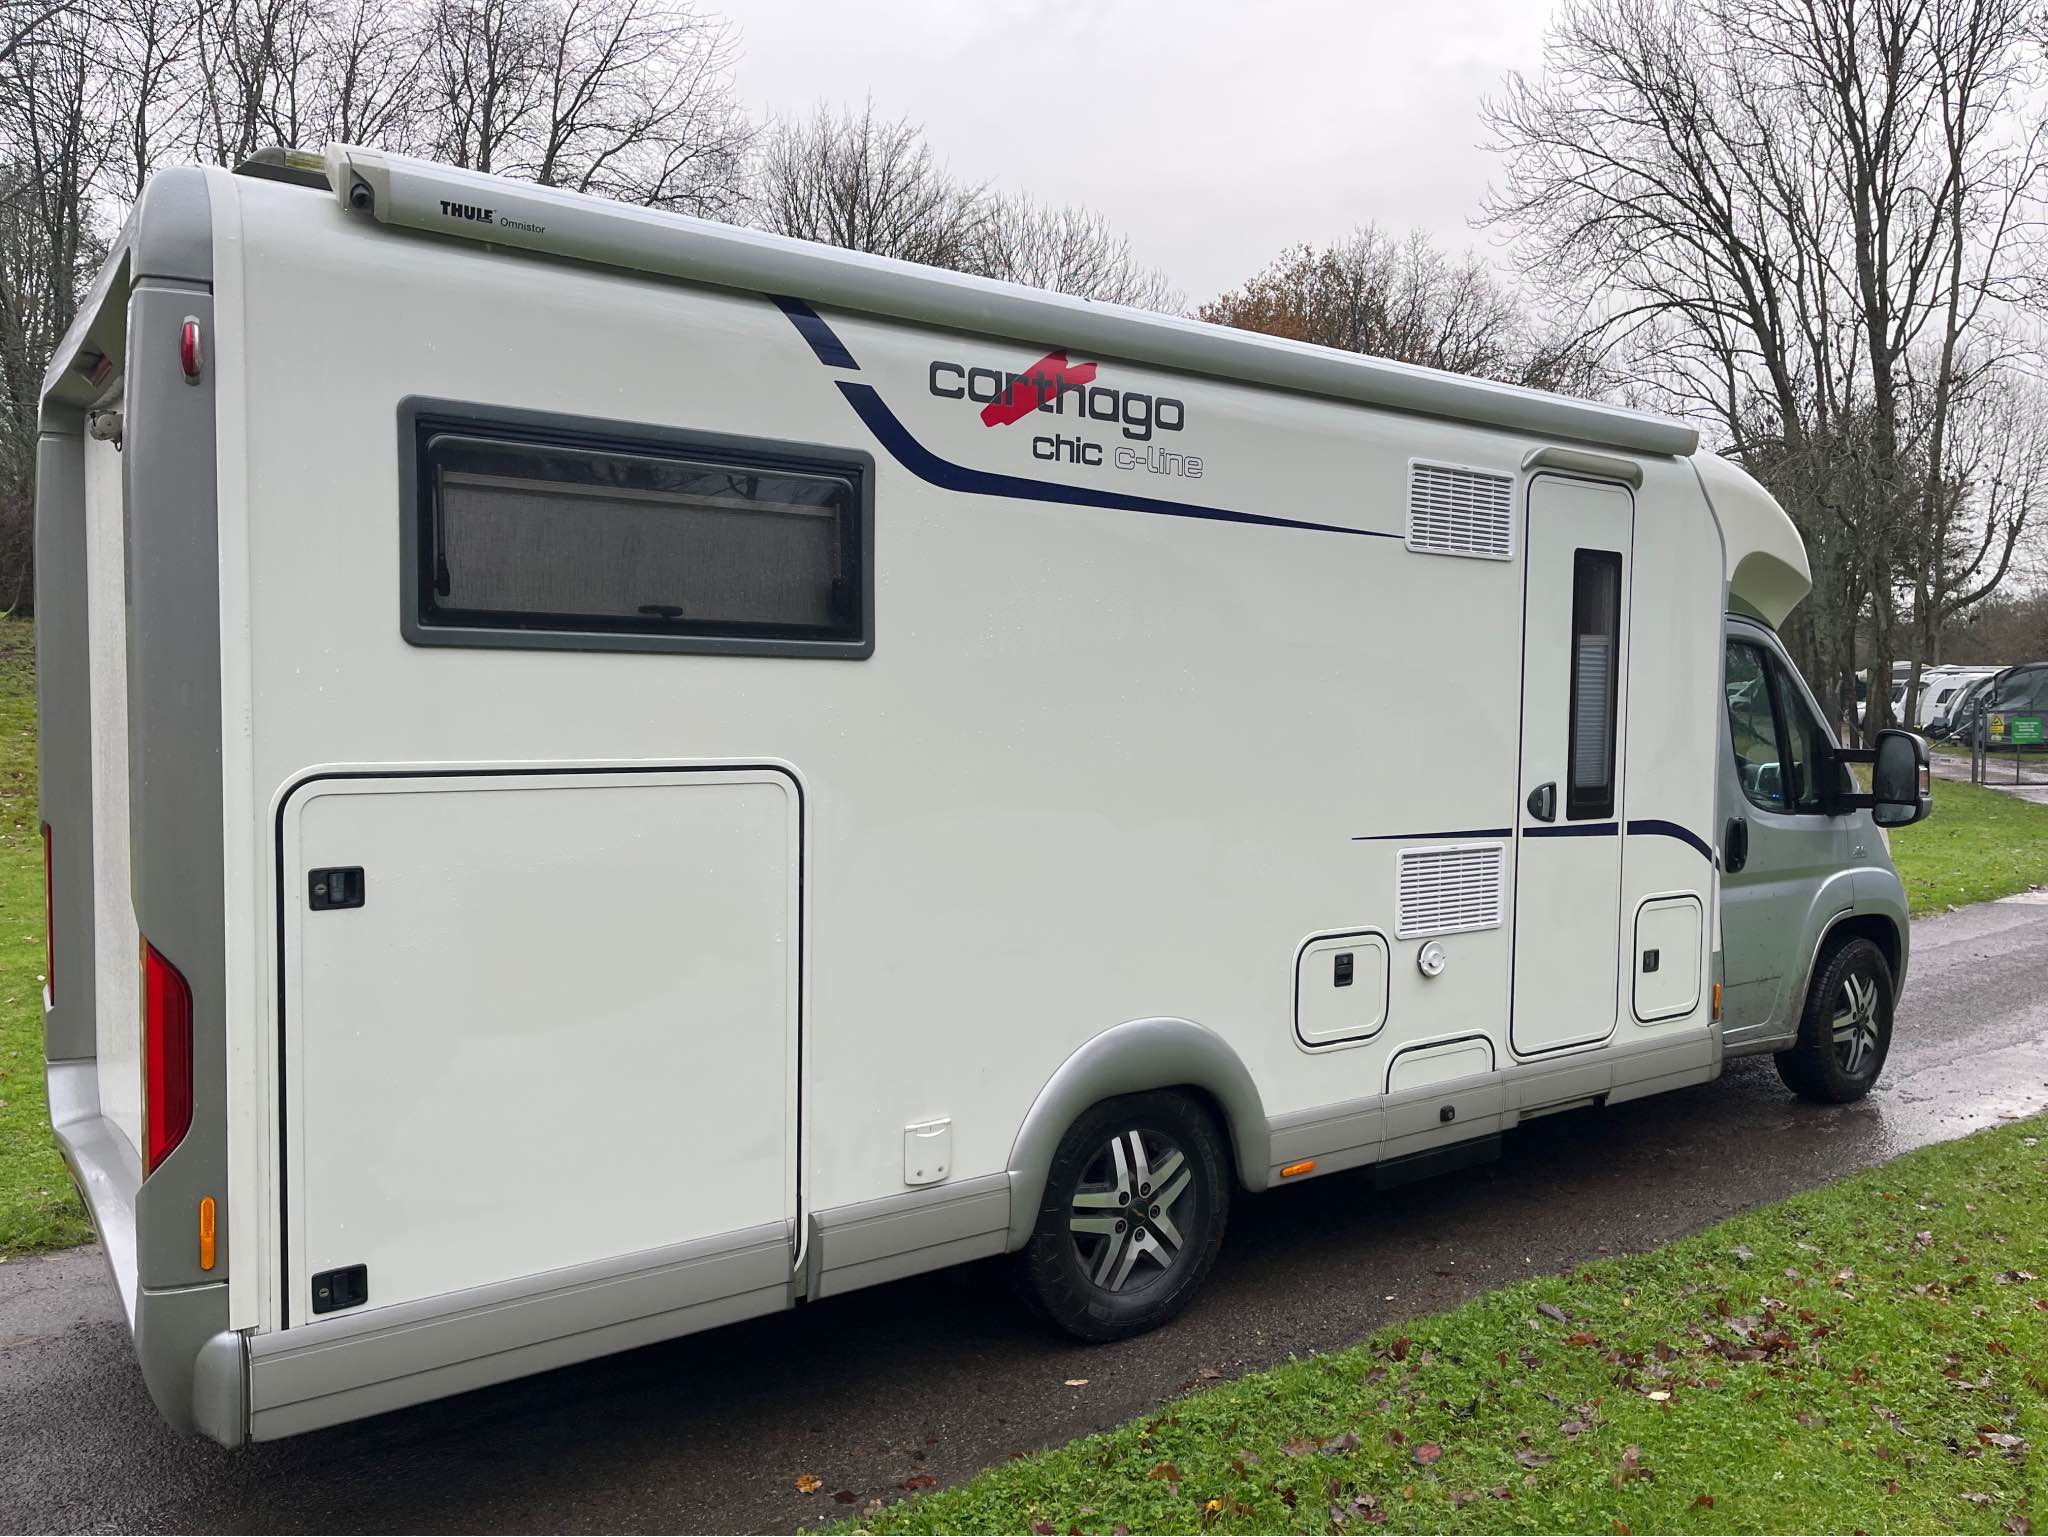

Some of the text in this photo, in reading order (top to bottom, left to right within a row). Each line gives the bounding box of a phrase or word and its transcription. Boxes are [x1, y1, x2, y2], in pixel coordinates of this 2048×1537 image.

[440, 200, 546, 234] THULE Omnistor
[929, 360, 1185, 441] carthago
[1032, 433, 1204, 479] chic c-line
